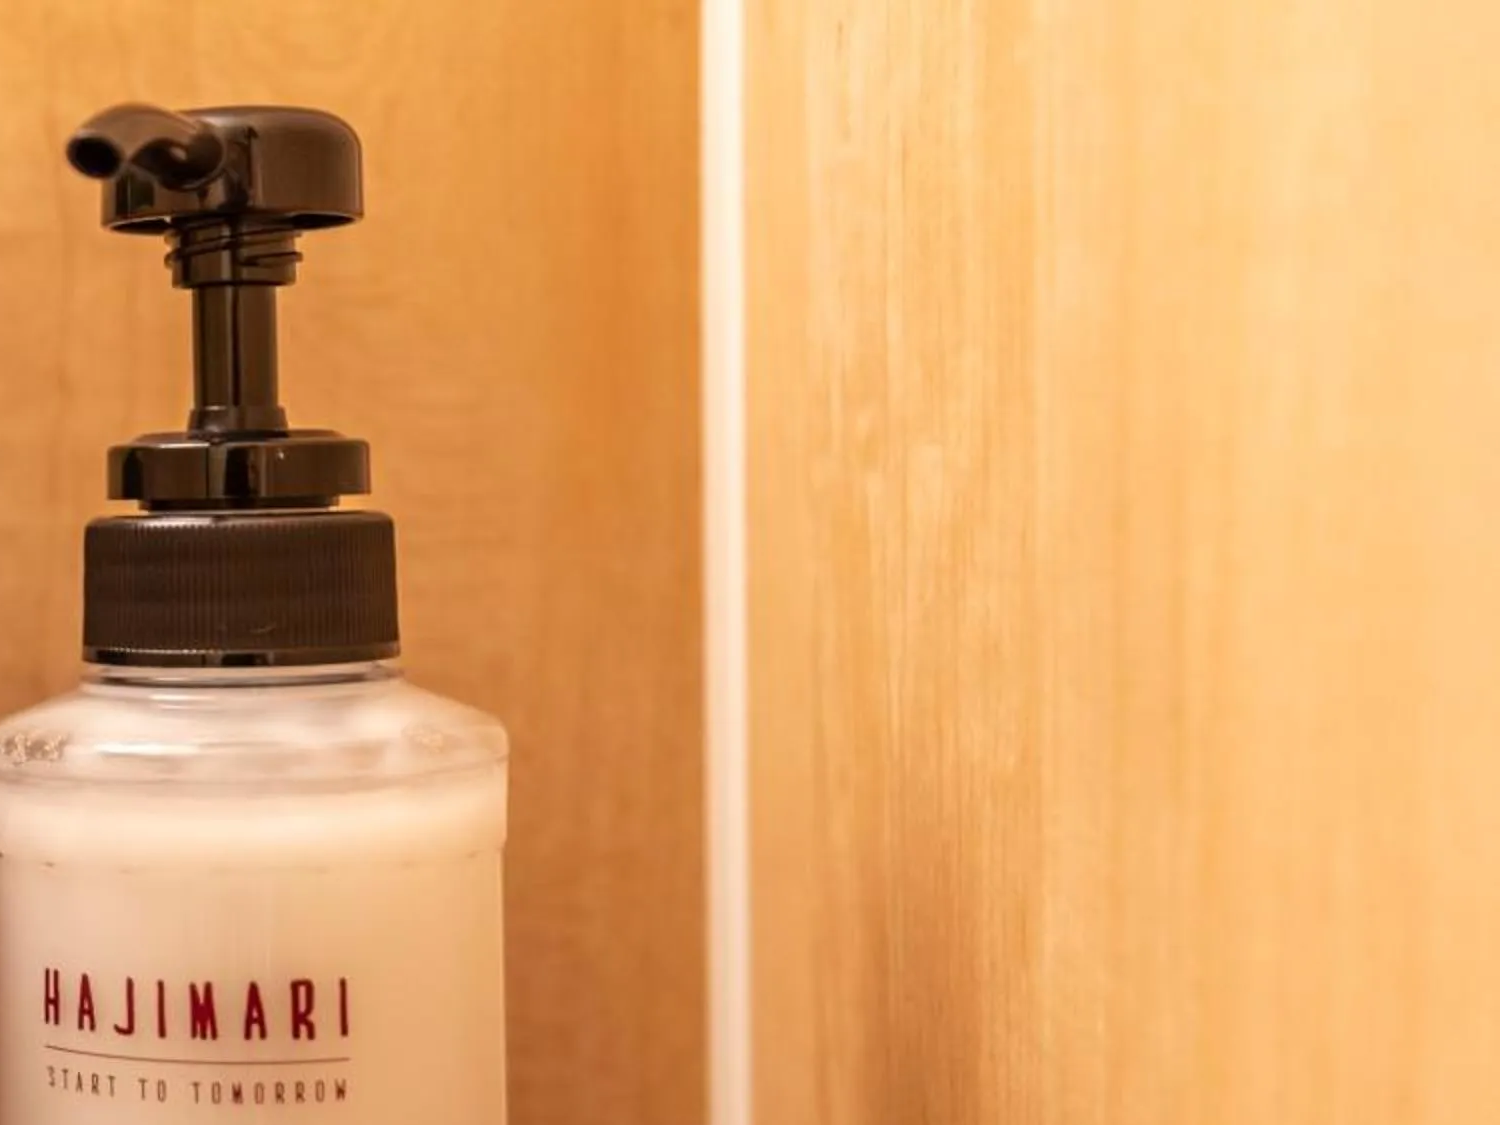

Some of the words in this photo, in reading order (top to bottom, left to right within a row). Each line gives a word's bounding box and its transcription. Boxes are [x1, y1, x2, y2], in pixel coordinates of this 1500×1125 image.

[44, 968, 349, 1041] HAJIMARI
[47, 1065, 116, 1097] START
[138, 1078, 167, 1103] TO
[191, 1079, 348, 1105] TOMORROW
